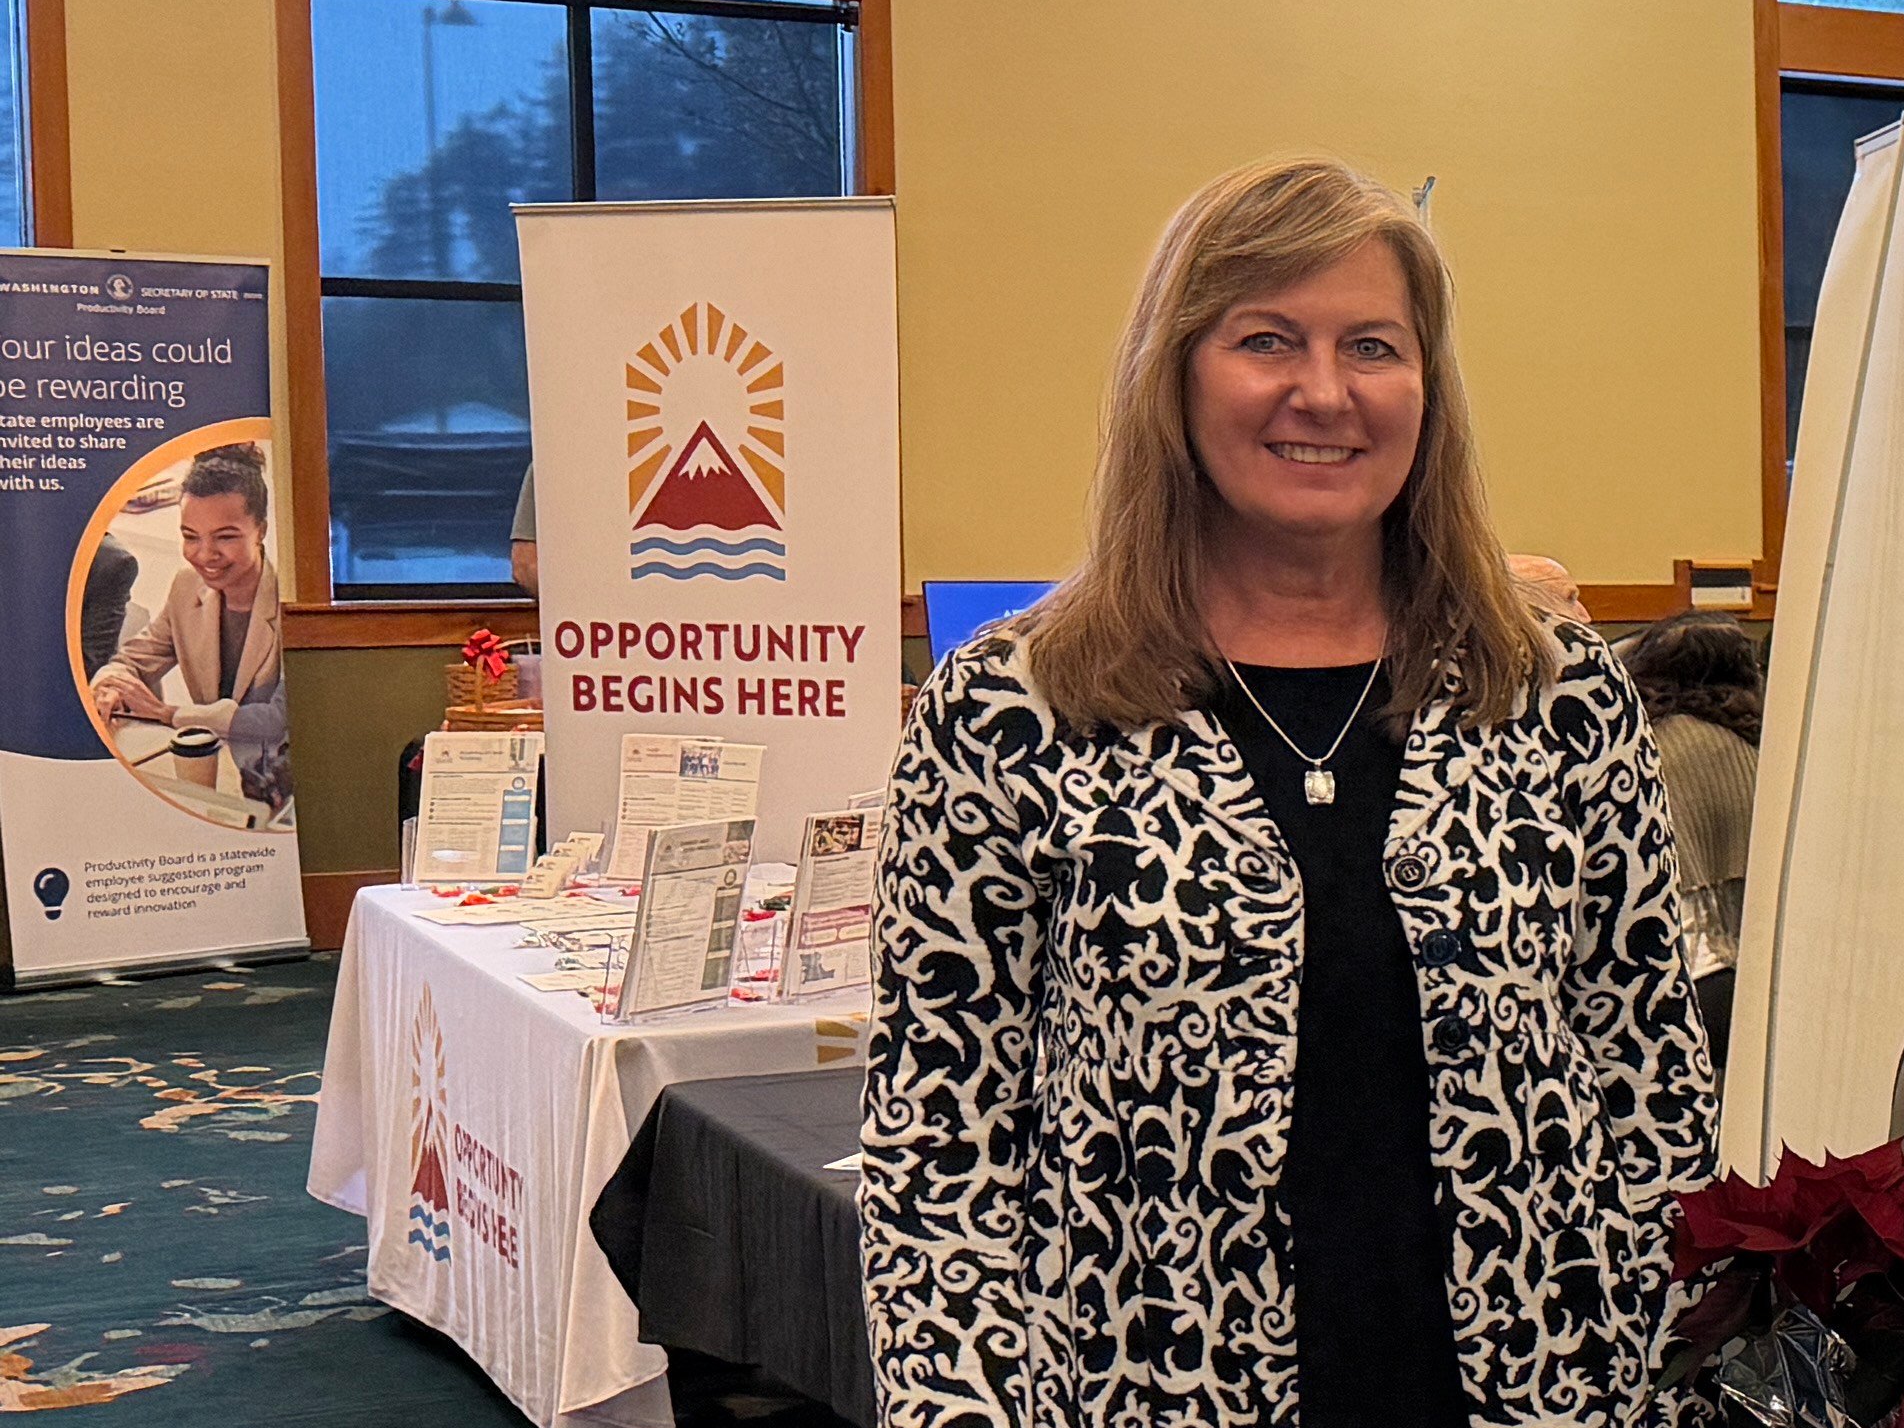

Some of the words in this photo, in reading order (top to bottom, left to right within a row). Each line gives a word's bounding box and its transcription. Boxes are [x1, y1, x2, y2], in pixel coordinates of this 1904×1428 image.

[0, 282, 100, 296] WASHINGTON
[210, 289, 239, 300] STATE
[76, 302, 134, 315] Productivity
[136, 304, 166, 315] Board
[0, 337, 57, 361] our
[64, 334, 143, 363] ideas
[152, 337, 232, 364] could
[37, 374, 186, 408] rewarding
[41, 413, 132, 431] employees
[136, 416, 165, 429] are
[57, 435, 75, 449] to
[79, 433, 127, 449] share
[41, 453, 87, 470] ideas
[39, 477, 65, 491] us.
[554, 620, 866, 664] OPPORTUNITY
[572, 674, 725, 715] BEGINS
[737, 677, 847, 718] HERE
[84, 858, 156, 873] Productivity
[159, 852, 195, 866] Board
[197, 852, 207, 863] is
[209, 853, 217, 863] a
[219, 847, 276, 862] statewide
[85, 873, 144, 890] employee
[148, 867, 210, 884] suggestion
[214, 863, 264, 879] program
[86, 887, 141, 905] designed
[144, 887, 157, 899] to
[160, 881, 221, 898] encourage
[224, 878, 246, 891] and
[87, 904, 131, 920] reward
[133, 898, 197, 914] innovation
